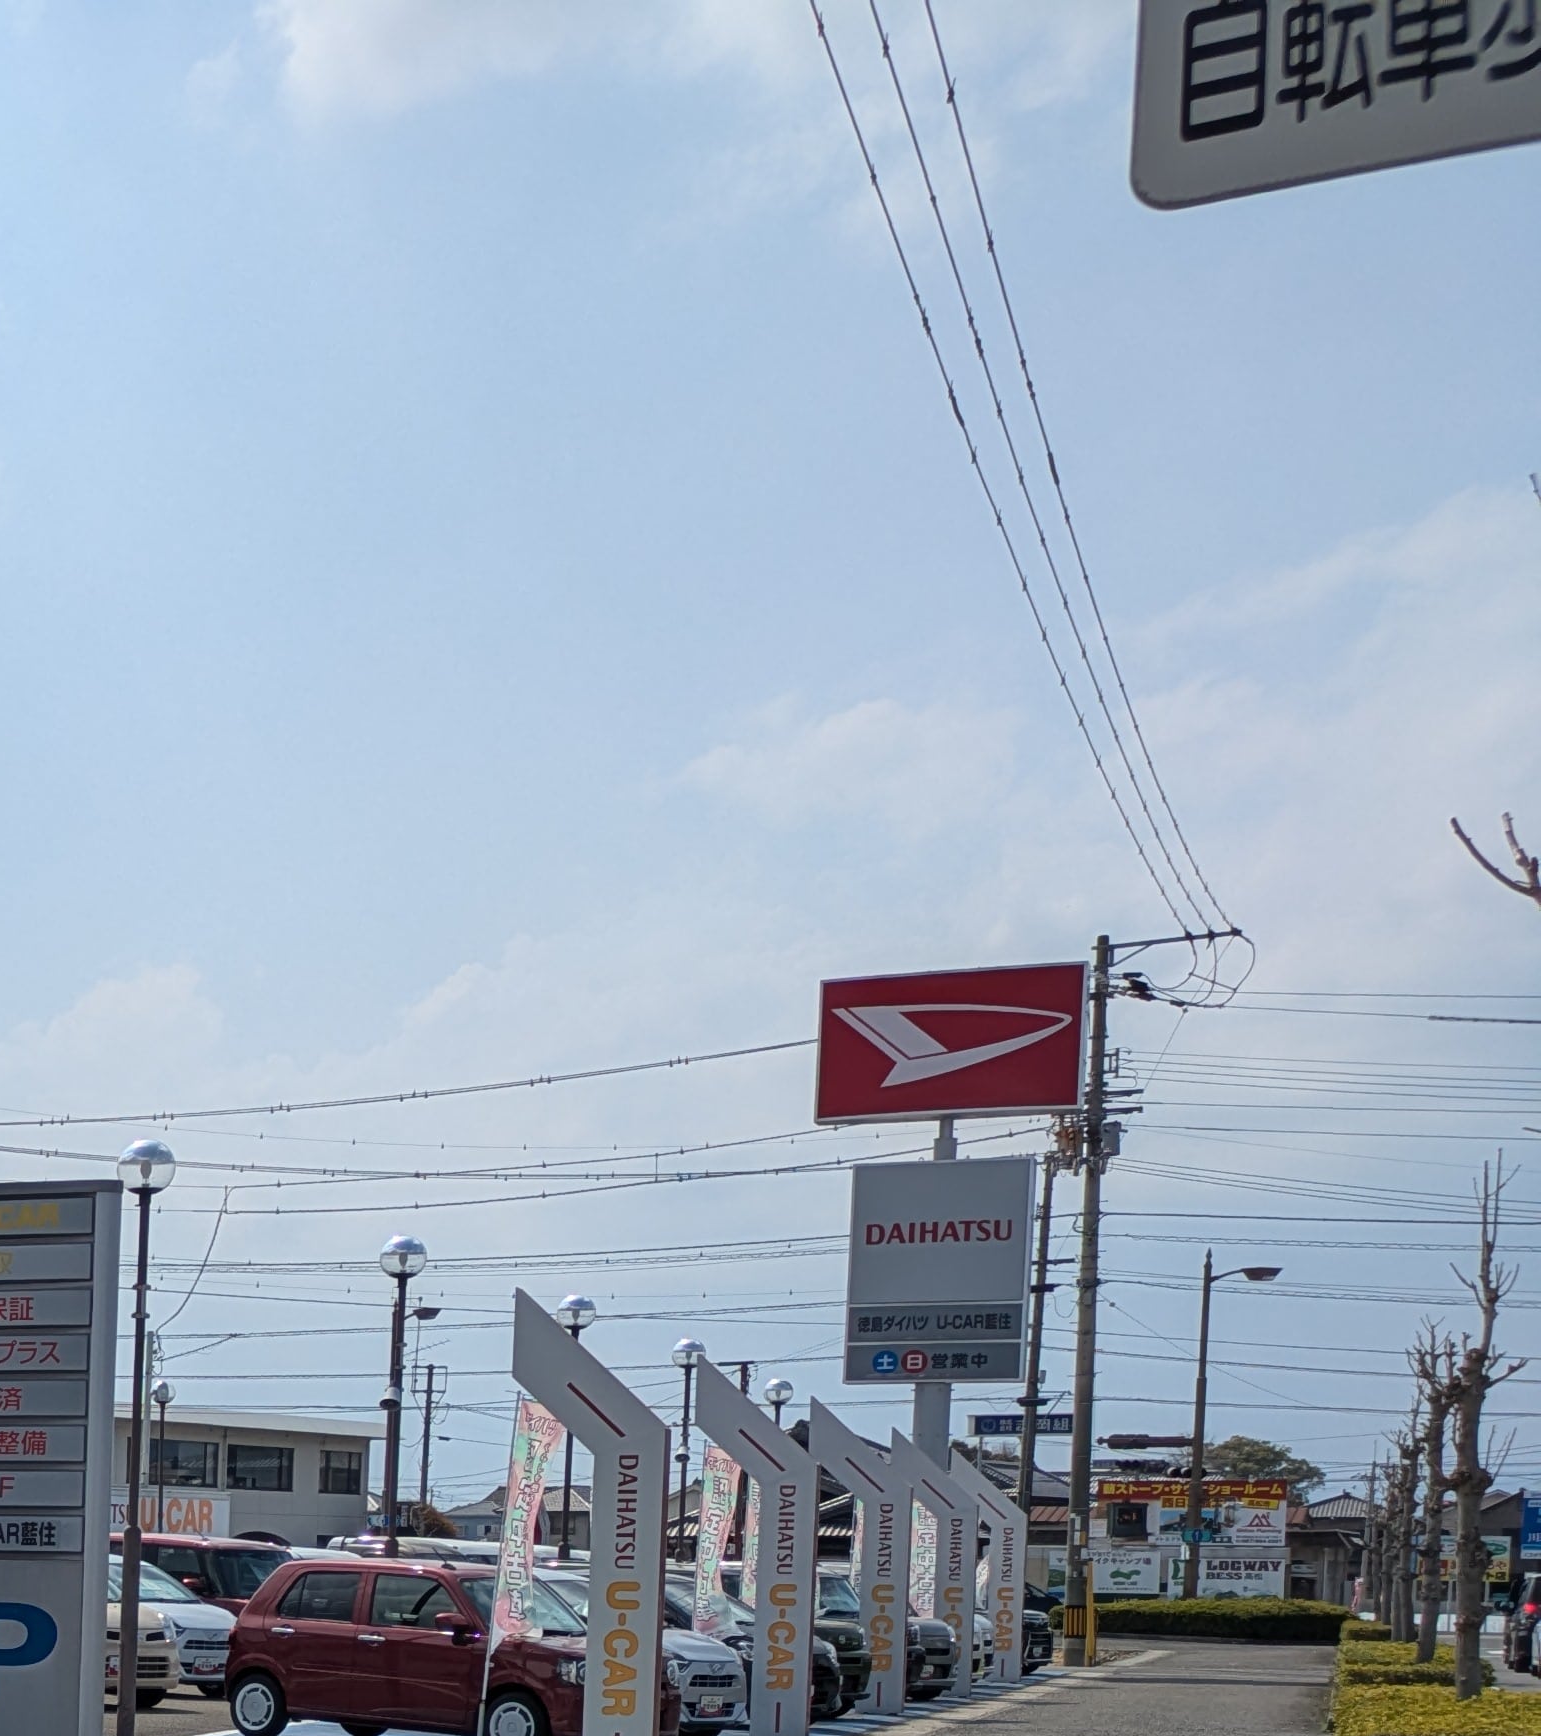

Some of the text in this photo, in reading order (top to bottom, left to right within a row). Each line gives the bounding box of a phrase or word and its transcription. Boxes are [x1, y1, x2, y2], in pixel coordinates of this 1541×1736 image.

[866, 1219, 1013, 1246] DAIHATSU
[858, 1315, 929, 1334] 徳島ダイハツ
[141, 1497, 214, 1534] UCAR
[949, 1518, 964, 1582] DAIHATSU
[1206, 1560, 1282, 1572] LOGWAY
[602, 1454, 641, 1717] DAIHATSU U-CAR
[767, 1484, 797, 1691] DAIHATSU U-CAR
[870, 1503, 896, 1673] DAIHATSU U-CAR
[994, 1527, 1014, 1653] DAIHATSU U-CAR
[1206, 1572, 1242, 1580] BESS
